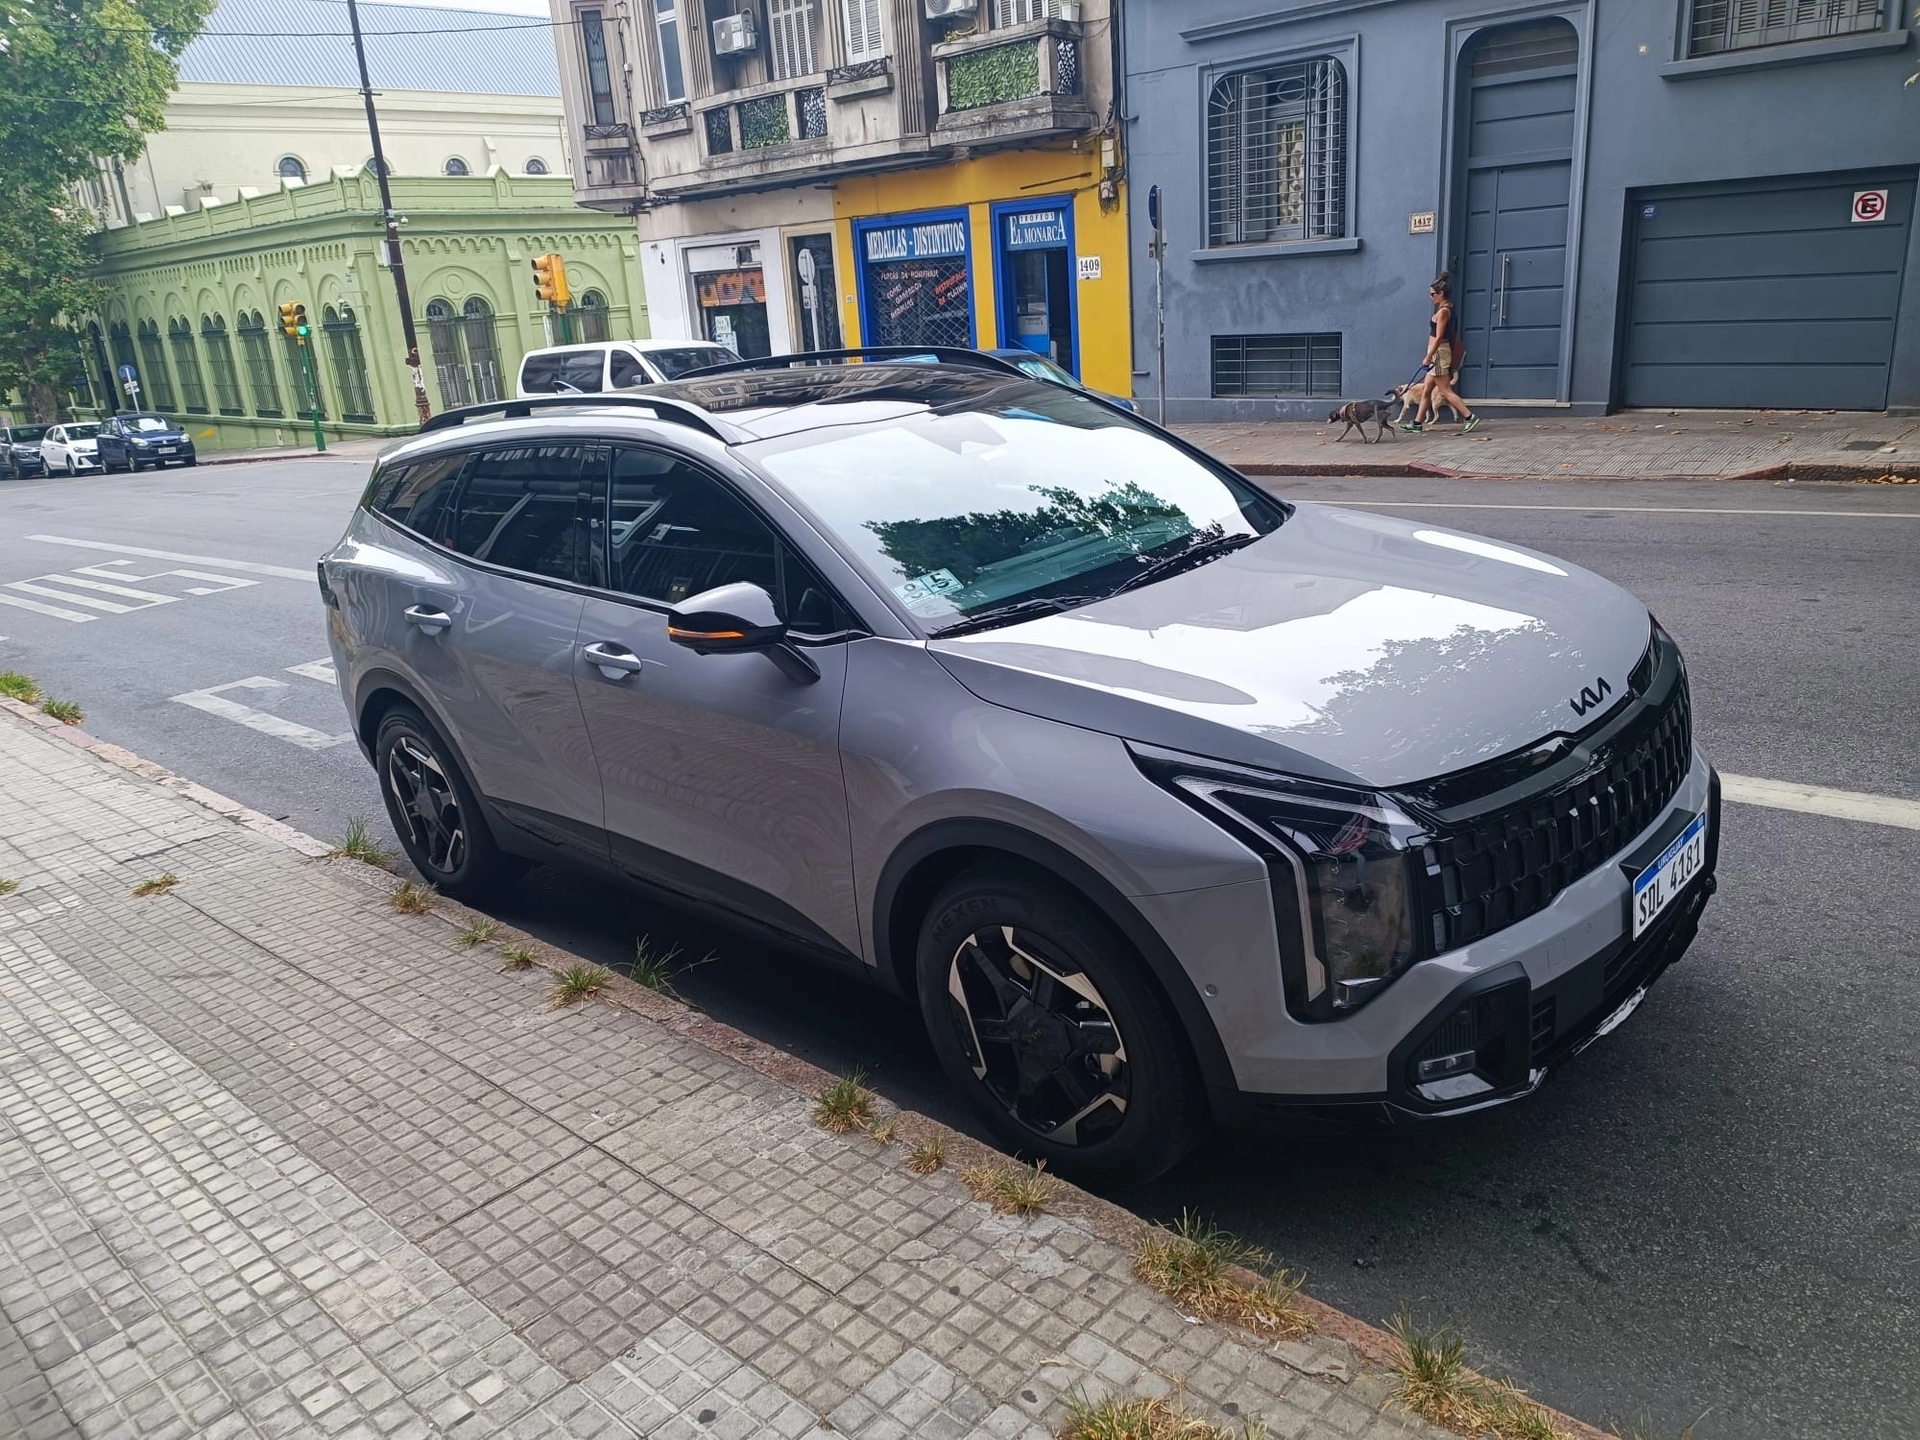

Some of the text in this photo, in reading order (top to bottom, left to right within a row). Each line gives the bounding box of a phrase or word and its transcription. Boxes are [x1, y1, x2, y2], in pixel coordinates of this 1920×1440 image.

[1020, 212, 1054, 223] TROFEOS
[1413, 217, 1432, 226] 1417
[866, 228, 908, 260] MEDALLAS
[912, 221, 966, 256] DISTINTIVOS
[1080, 258, 1100, 271] 1409
[1570, 677, 1611, 717] KIA
[1657, 835, 1686, 870] URUGUAY
[1670, 836, 1701, 892] 4181
[931, 898, 999, 944] NEXEN
